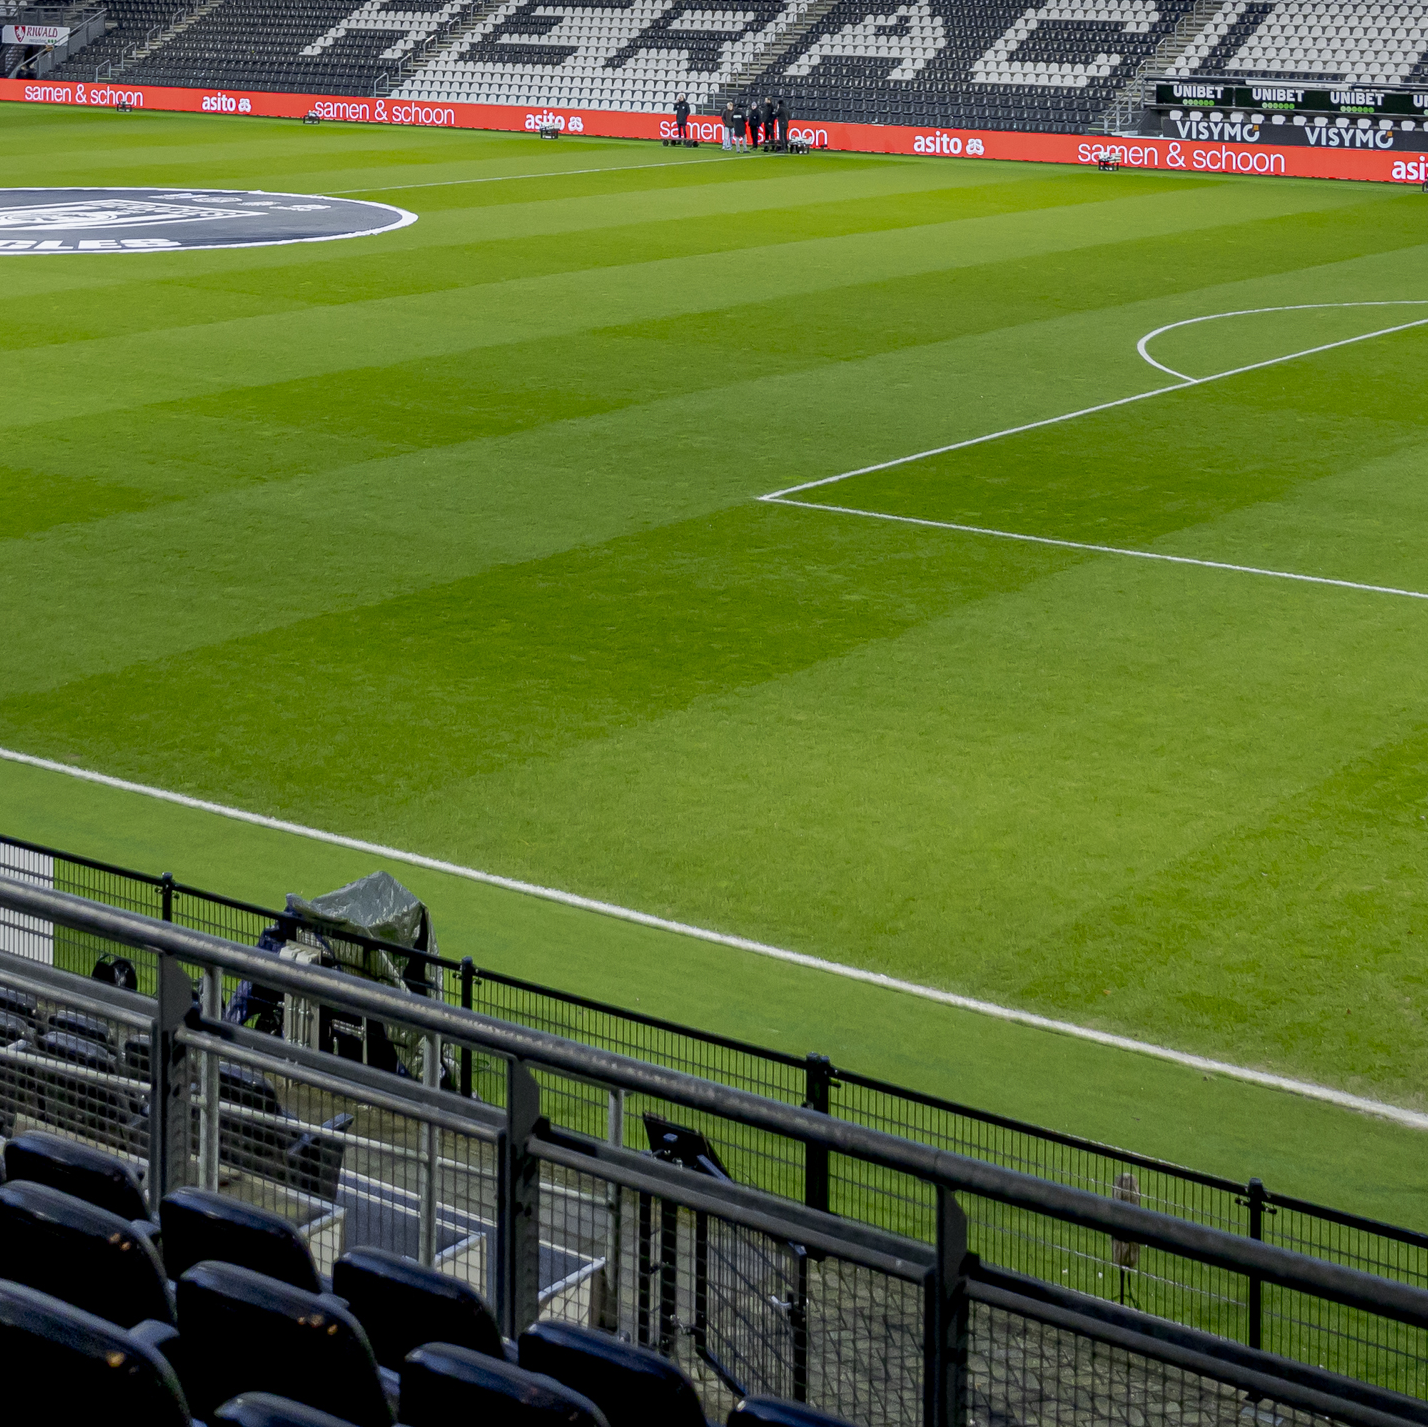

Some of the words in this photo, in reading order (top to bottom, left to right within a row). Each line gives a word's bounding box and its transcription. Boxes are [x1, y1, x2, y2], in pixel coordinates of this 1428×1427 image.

[26, 27, 58, 38] RIWALD
[24, 83, 72, 102] samen
[75, 83, 88, 103] &
[90, 84, 144, 107] schoon
[201, 91, 236, 113] asito
[1173, 84, 1224, 99] UNIBET
[1251, 87, 1304, 102] UNIBET
[1330, 90, 1384, 106] UNIBET
[314, 99, 370, 121] samen
[374, 99, 389, 122] &
[392, 100, 455, 125] schoon
[525, 109, 565, 132] asito
[913, 130, 962, 155] asito
[1175, 120, 1261, 143] VISYMO
[1304, 125, 1394, 149] VISYMO
[1077, 142, 1159, 166] samen
[1165, 141, 1186, 168] &
[1192, 144, 1285, 173] schoon
